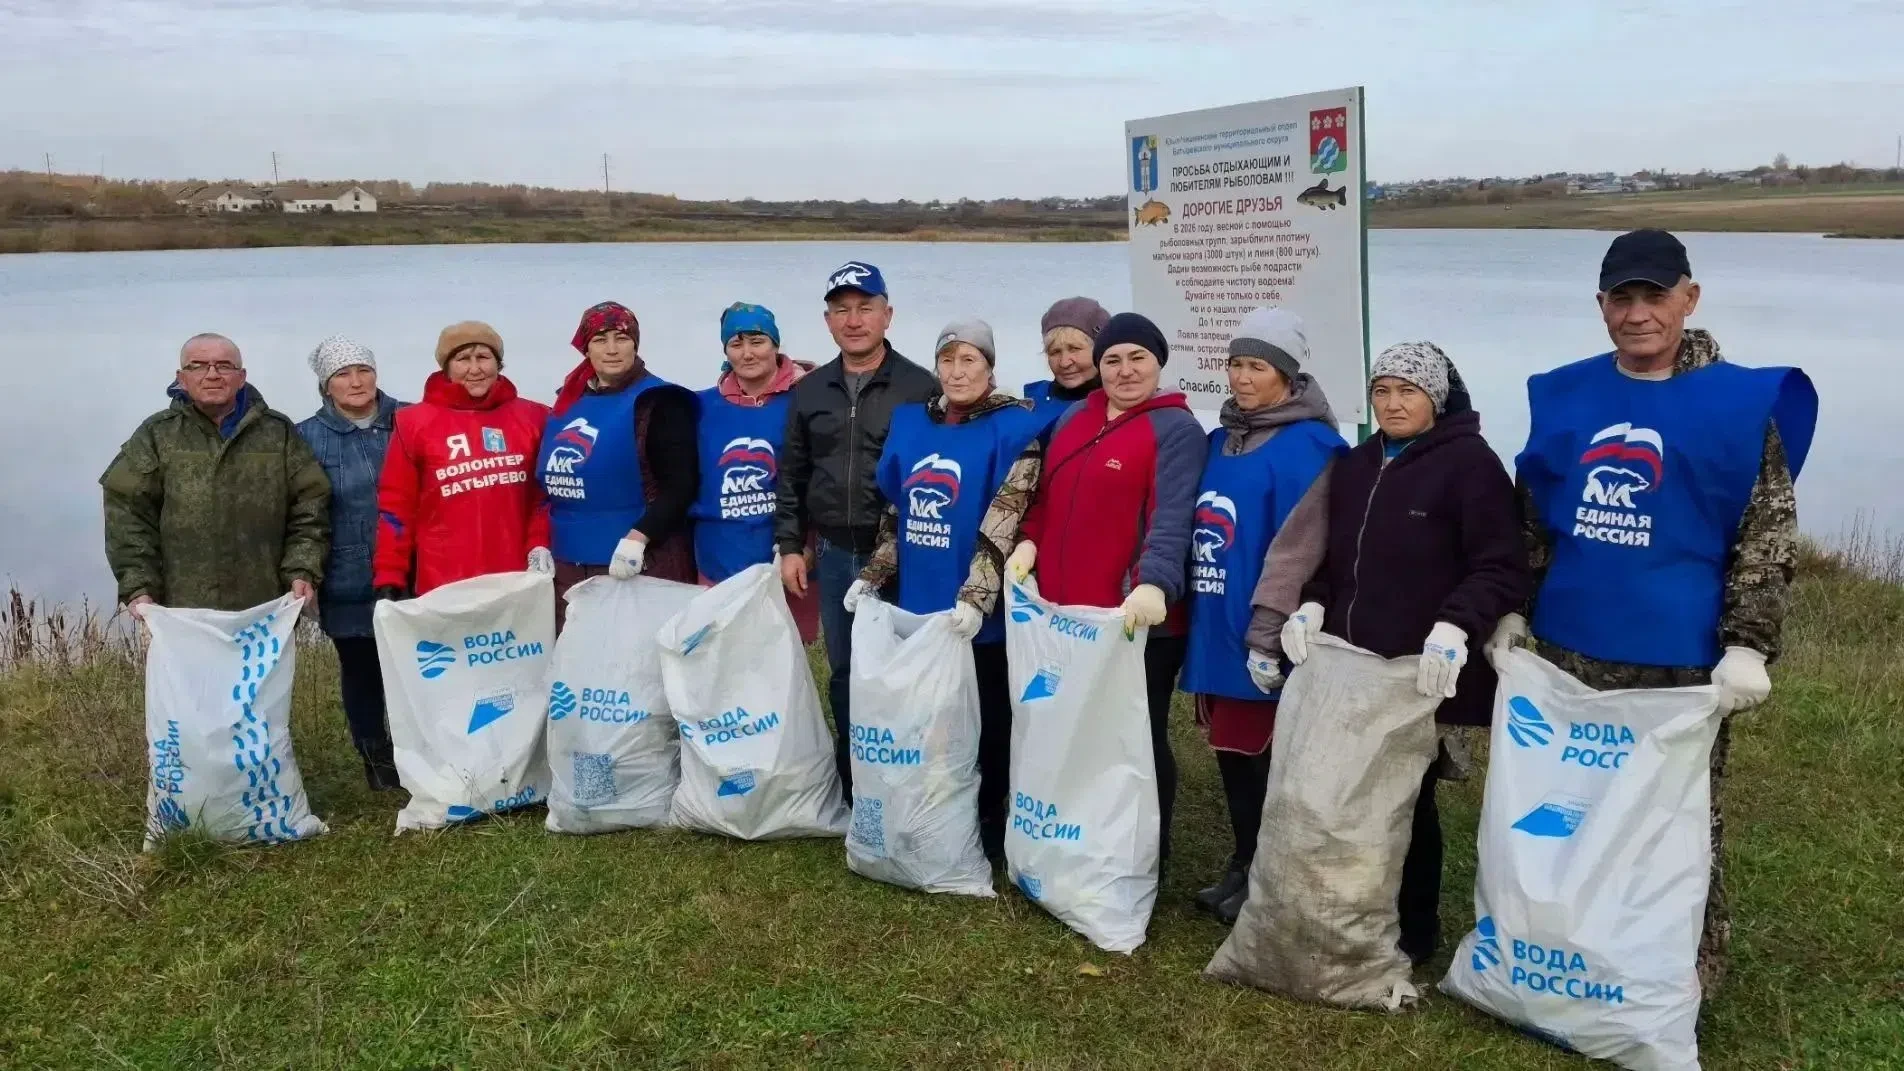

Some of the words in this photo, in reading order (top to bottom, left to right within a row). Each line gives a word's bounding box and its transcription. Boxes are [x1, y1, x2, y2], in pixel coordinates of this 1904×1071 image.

[1172, 164, 1211, 178] ПРОСЬБА
[1212, 156, 1282, 174] ОТДЫХАЮЩИМ
[1283, 154, 1291, 167] И
[1170, 178, 1222, 193] ЛЮБИТЕЛЯМ
[1223, 172, 1283, 188] РЫБОЛОВАМ
[1284, 171, 1295, 183] !!!
[1182, 200, 1233, 219] ДОРОГИЕ
[1236, 195, 1283, 215] ДРУЗЬЯ
[1173, 223, 1179, 233] В
[1251, 219, 1292, 230] помощью
[1160, 237, 1204, 248] рыболовных
[1230, 233, 1274, 247] зарыблили
[1275, 232, 1311, 244] плотину
[1247, 249, 1253, 258] и
[1254, 248, 1275, 258] линя
[1276, 246, 1293, 260] (800
[1191, 264, 1239, 274] возможность
[1240, 261, 1261, 274] рыбе
[1263, 262, 1303, 273] подрасти
[1226, 277, 1256, 289] чистоту
[1216, 292, 1225, 300] не
[1226, 292, 1253, 300] только
[1254, 292, 1260, 300] о
[1200, 305, 1206, 313] и
[1207, 305, 1212, 313] о
[1213, 305, 1237, 315] наших
[1198, 316, 1209, 328] До
[1197, 356, 1230, 372] ЗАПРЕ
[1179, 377, 1222, 394] Спасибо
[446, 433, 472, 460] Я
[435, 454, 525, 481] ВОЛОНТЕР
[440, 471, 528, 497] БАТЫРЕВО
[544, 474, 584, 487] ЕДИНАЯ
[547, 486, 586, 500] РОССИЯ
[719, 491, 777, 509] ЕДИНАЯ
[721, 503, 777, 520] РОССИЯ
[1575, 506, 1652, 529] ЕДИНАЯ
[906, 518, 951, 535] ЕДИНАЯ
[1572, 522, 1651, 547] РОССИЯ
[905, 531, 950, 549] РОССИЯ
[1050, 614, 1099, 641] РОССИИ
[463, 629, 517, 649] ВОДА
[467, 640, 544, 667] РОССИИ
[581, 687, 631, 706] ВОДА
[697, 706, 750, 732] ВОДА
[704, 711, 780, 746] РОССИИ
[1568, 721, 1636, 746] ВОДА
[1560, 745, 1630, 769] РОСС
[1015, 791, 1058, 821] ВОДА
[1013, 814, 1081, 841] РОССИИ
[1512, 938, 1587, 973] ВОДА
[1511, 966, 1624, 1004] РОССИИ
